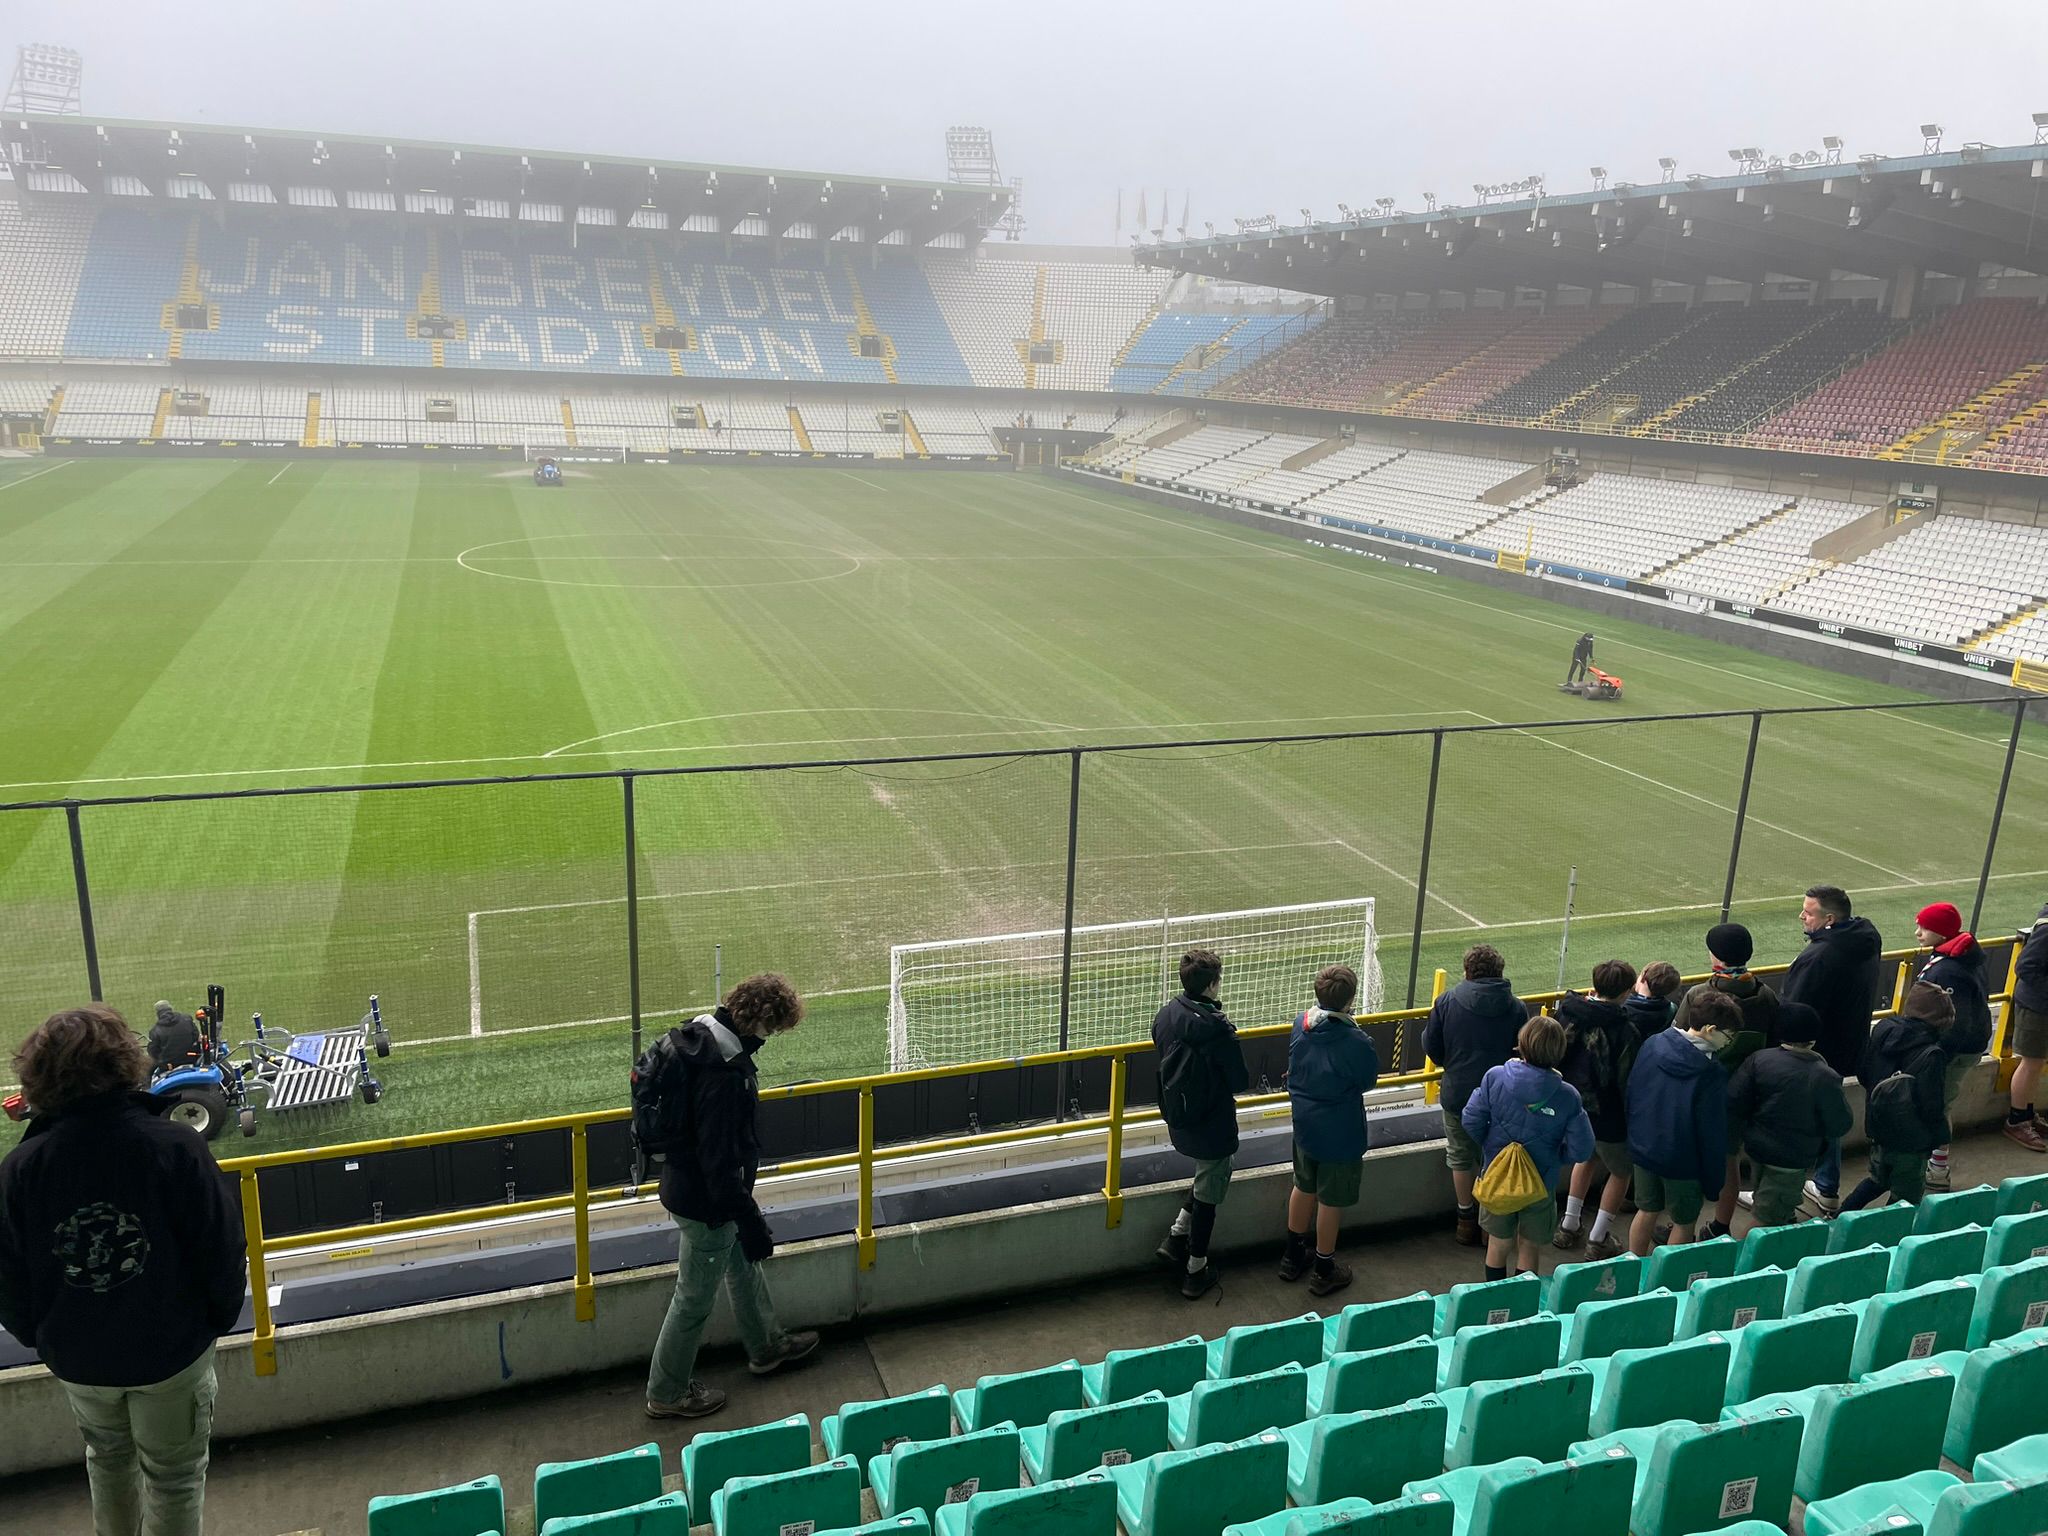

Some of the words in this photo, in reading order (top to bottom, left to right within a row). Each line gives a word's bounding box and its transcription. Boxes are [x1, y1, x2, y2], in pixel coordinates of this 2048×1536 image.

[199, 237, 405, 301] JAN
[462, 249, 859, 324] BREYDEL
[263, 304, 826, 374] STADION
[1818, 621, 1846, 635] UNIBET
[1894, 638, 1924, 652] UNIBET
[1963, 653, 1996, 668] UNIBET
